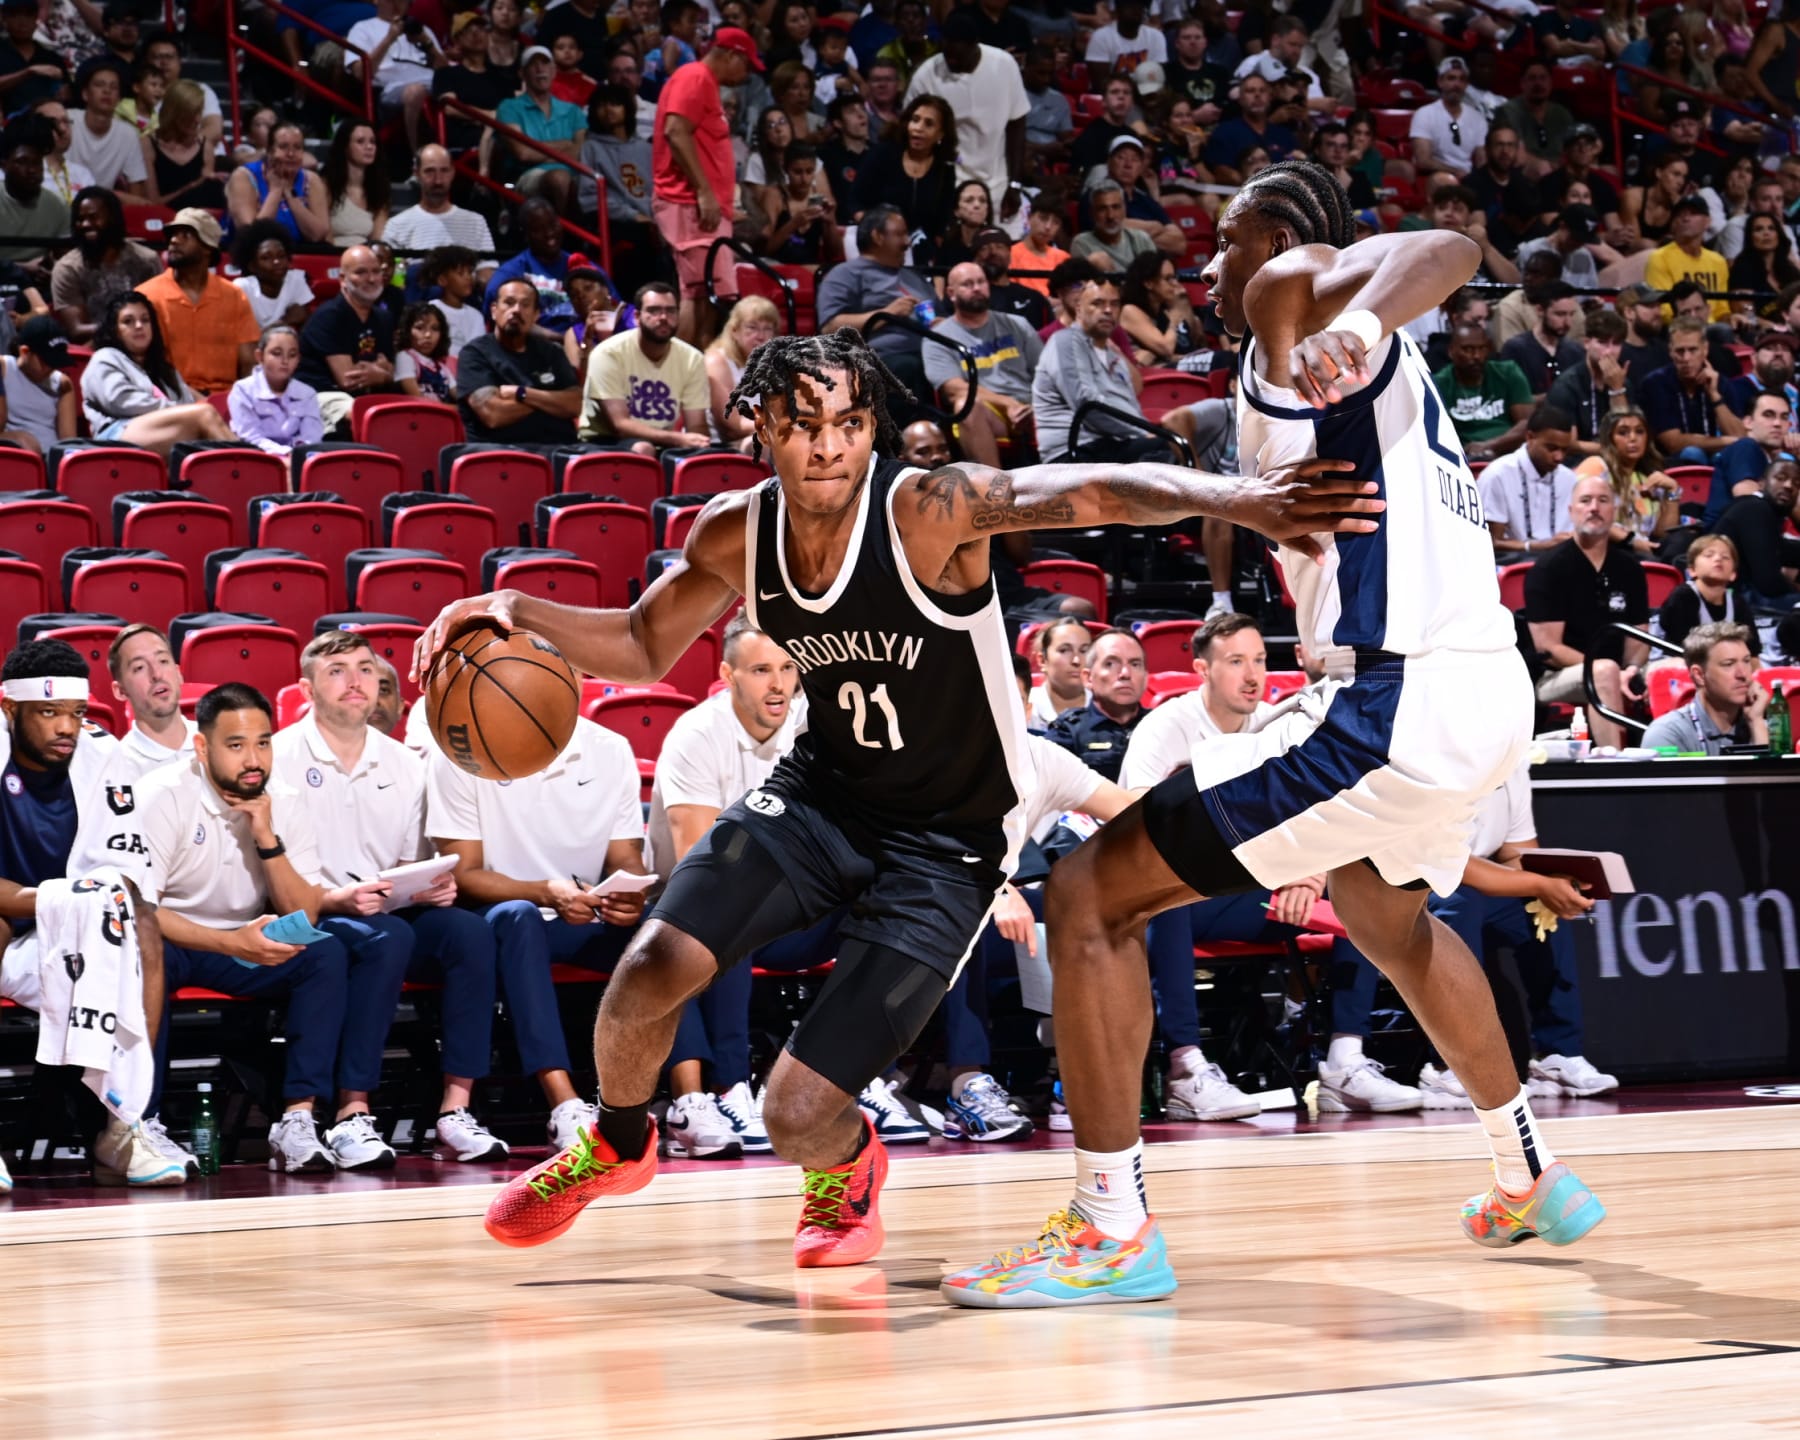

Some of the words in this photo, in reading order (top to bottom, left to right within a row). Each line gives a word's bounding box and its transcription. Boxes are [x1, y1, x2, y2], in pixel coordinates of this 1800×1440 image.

[627, 398, 677, 422] LESS
[793, 631, 924, 674] ROOKLYN
[838, 681, 905, 751] 21
